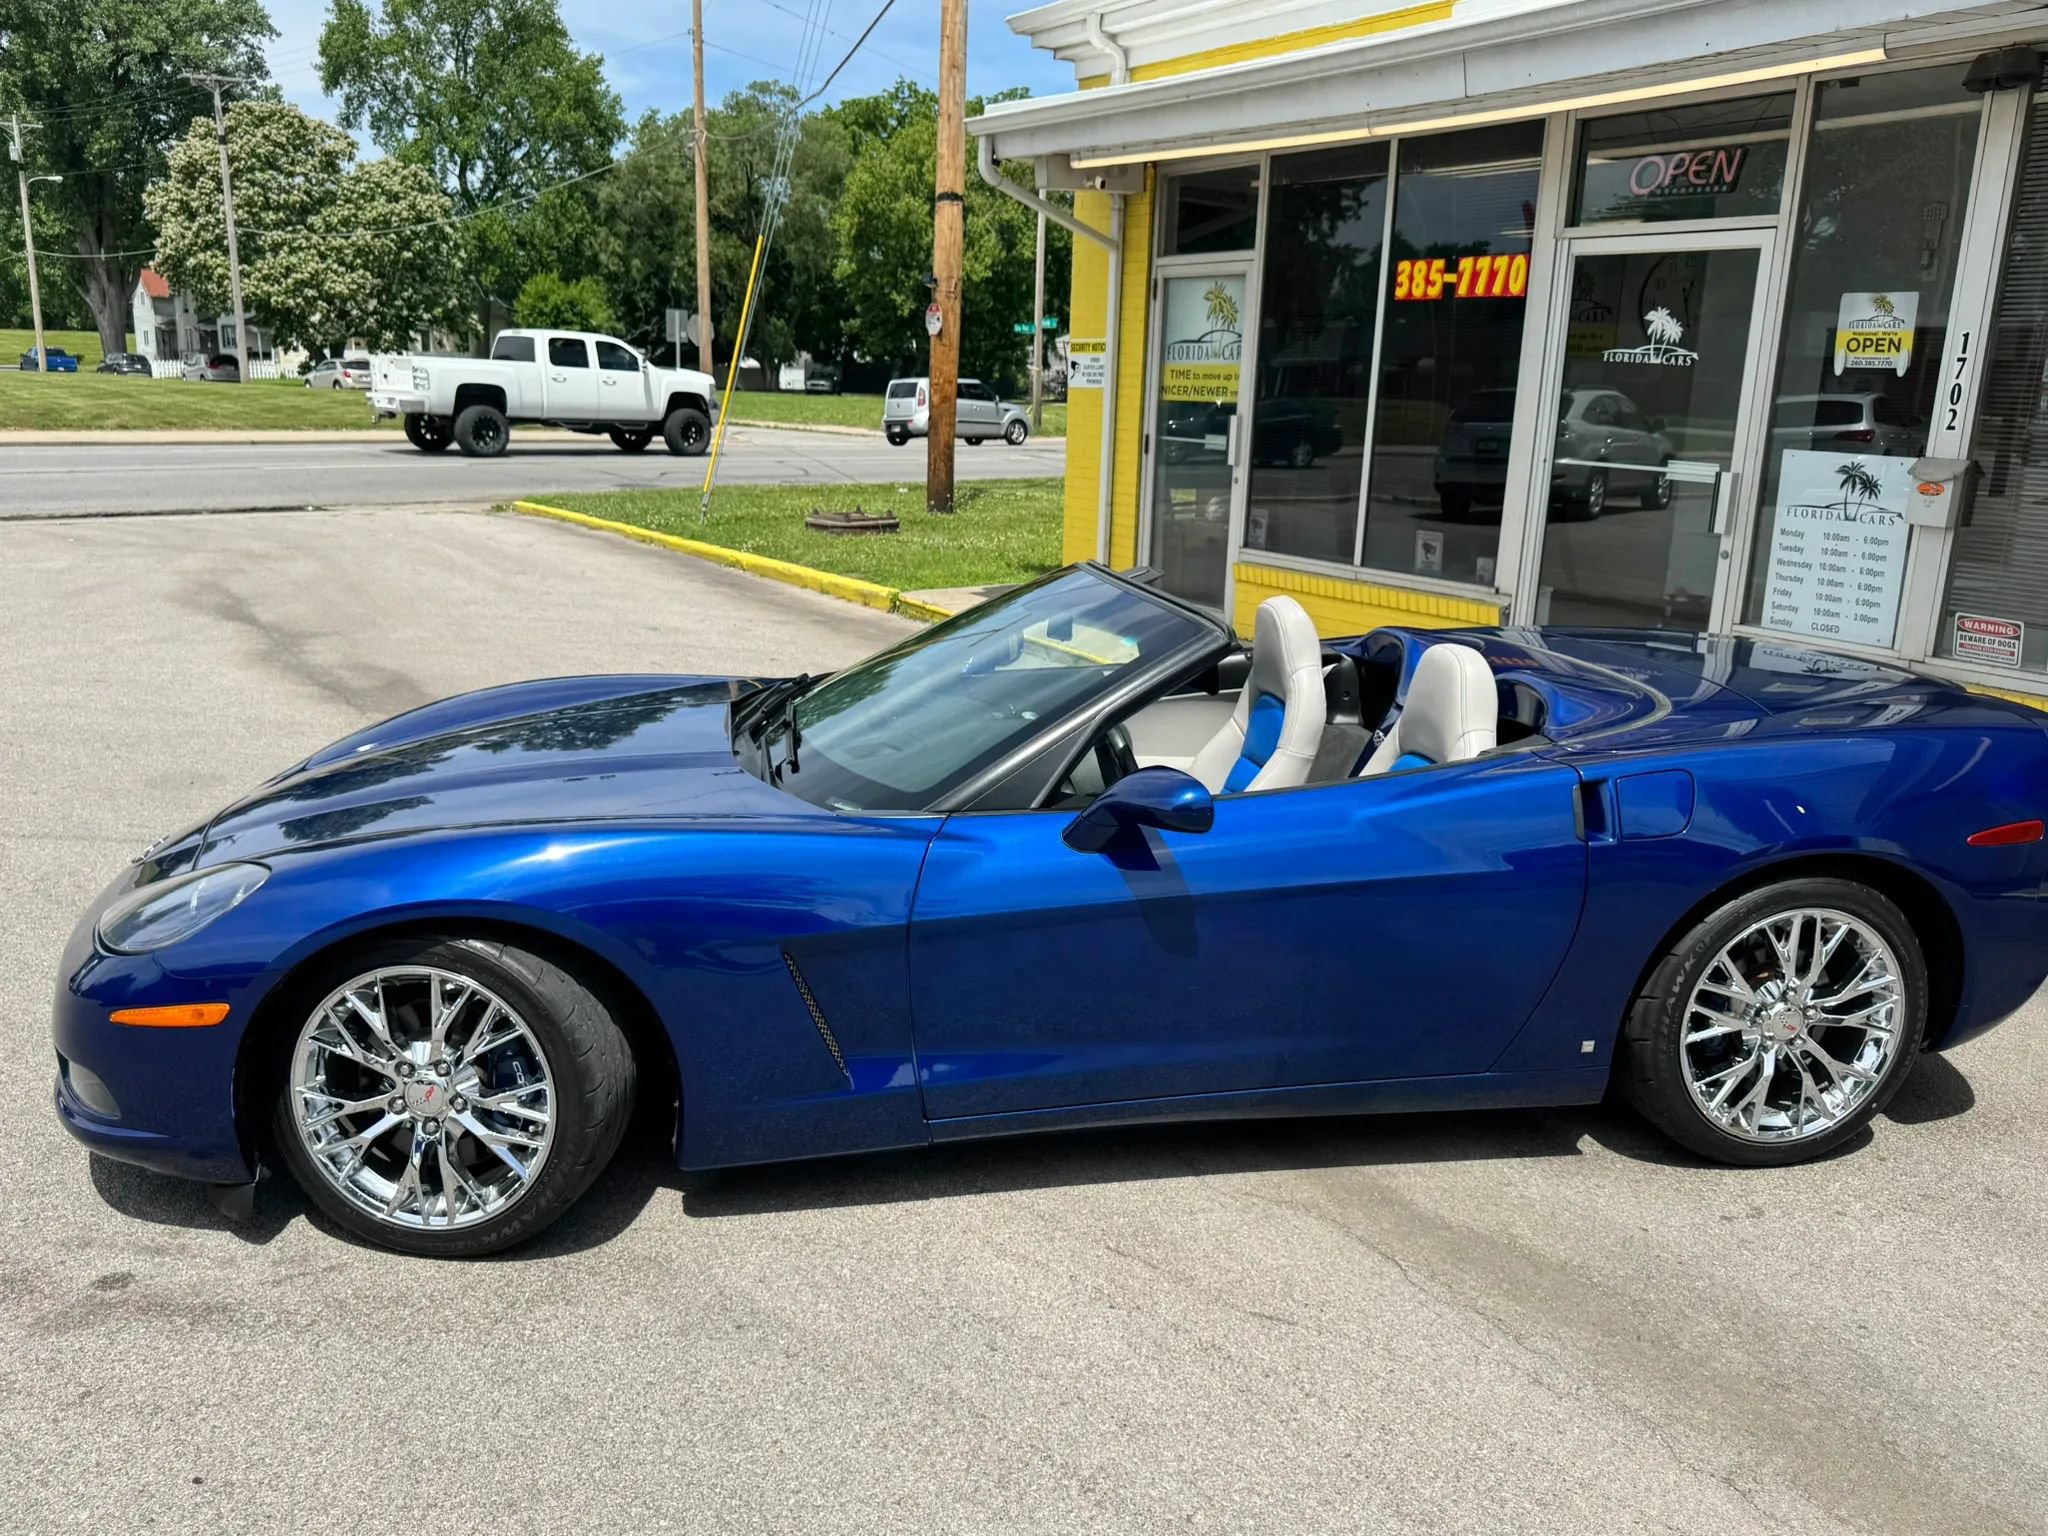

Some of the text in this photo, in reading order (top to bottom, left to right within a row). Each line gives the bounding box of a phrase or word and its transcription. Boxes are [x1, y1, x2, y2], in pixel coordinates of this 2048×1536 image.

[1628, 149, 1742, 197] OPEN
[1394, 253, 1529, 300] 385-7770
[1849, 321, 1901, 329] FLORIDA CARS
[1070, 343, 1090, 352] SECURITY
[1167, 344, 1209, 360] FLORIDA
[1846, 337, 1902, 353] OPEN
[1603, 351, 1693, 367] FLORIDA CARS
[1170, 369, 1192, 380] TIME
[1193, 372, 1200, 380] to
[1202, 373, 1221, 381] move
[1223, 373, 1232, 382] up
[1945, 331, 1970, 430] 1702
[1161, 385, 1228, 397] NICER/NEWER
[1786, 507, 1895, 526] FLORIDA CARS
[1780, 528, 1805, 540] Monday
[1823, 532, 1850, 542] 10:00am
[1863, 536, 1889, 547] 6:00pm
[1778, 543, 1804, 555] Tuesday
[1821, 547, 1848, 558] 10:00am
[1861, 551, 1887, 562] 6:00pm
[1776, 558, 1813, 571] Wednesday
[1819, 562, 1846, 573] 10:00am
[1859, 567, 1885, 578] 6:00pm
[1775, 573, 1804, 585] Thursday
[1817, 577, 1844, 588] 10:00am
[1857, 582, 1883, 594] 6:00pm
[1773, 587, 1793, 599] Friday
[1815, 593, 1842, 604] 10:00am
[1855, 597, 1881, 609] 6:00pm
[1771, 601, 1799, 614] Saturday
[1813, 608, 1840, 619] 10:00am
[1853, 613, 1879, 624] 3:00pm
[1769, 616, 1840, 634] Sunday CLOSED
[1964, 620, 2014, 635] WARNING
[1959, 634, 2017, 649] BEWARE OF DOGS
